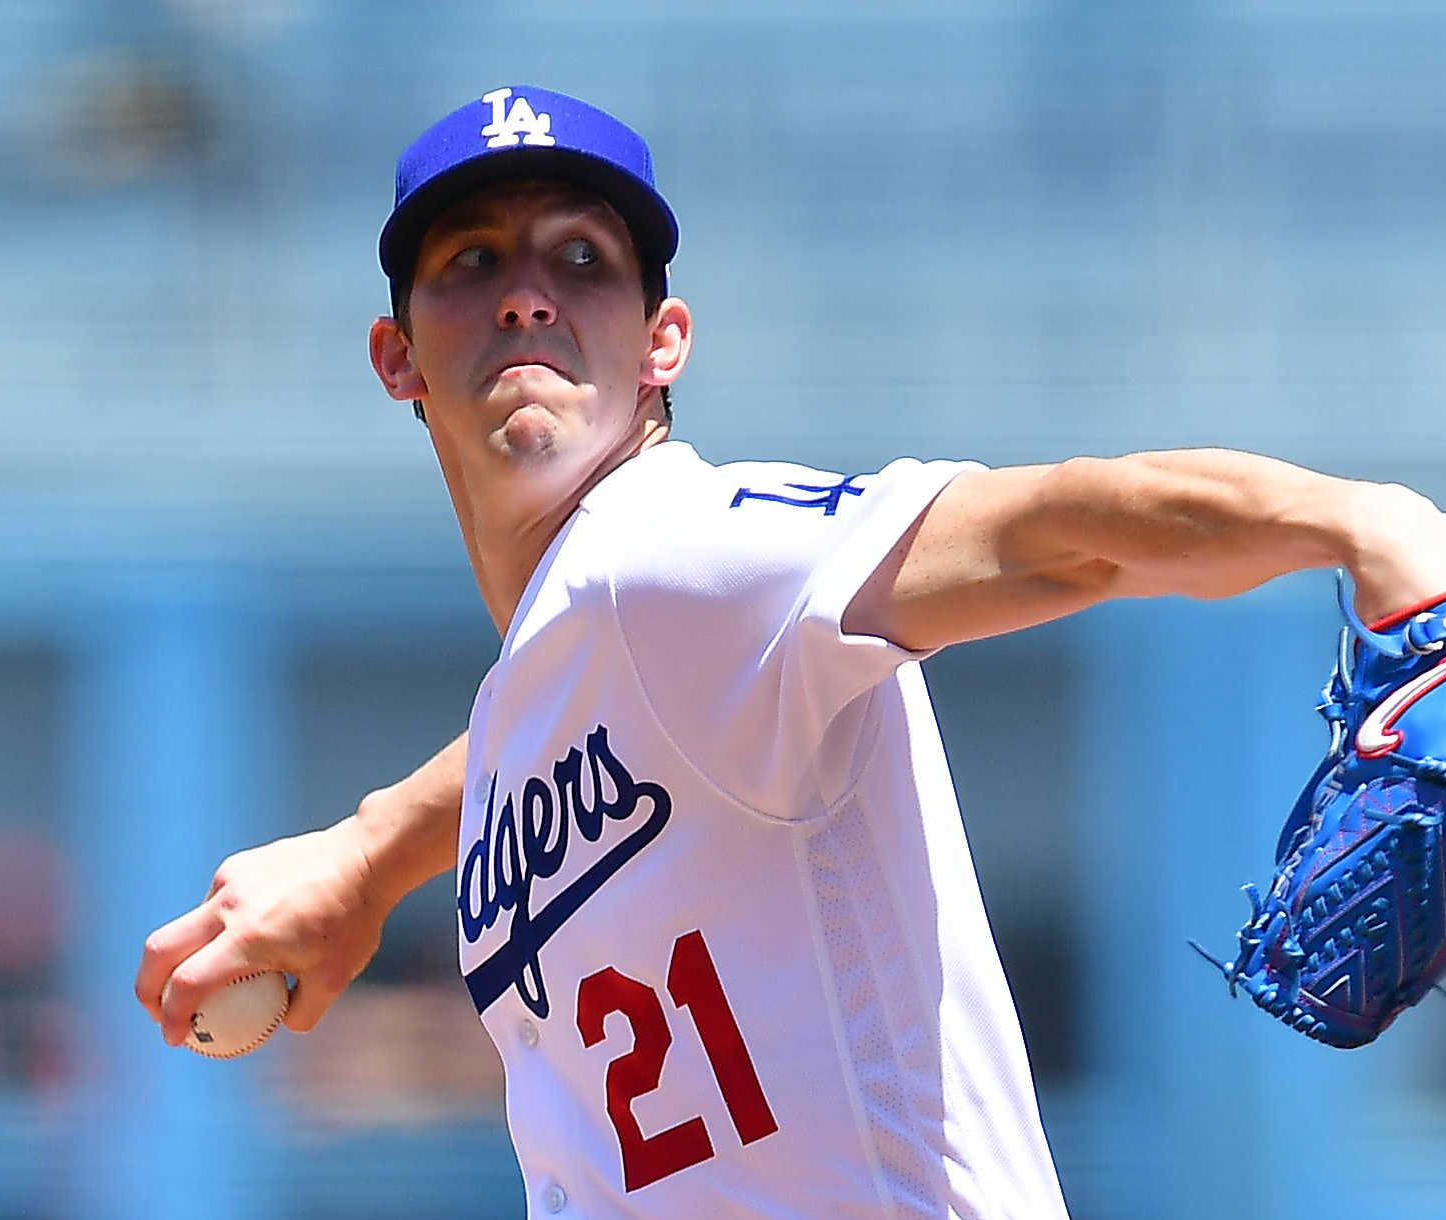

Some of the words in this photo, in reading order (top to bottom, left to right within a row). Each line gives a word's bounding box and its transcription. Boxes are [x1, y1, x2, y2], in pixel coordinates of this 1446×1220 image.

[481, 87, 556, 148] LA
[457, 723, 672, 1020] dgers
[576, 928, 779, 1194] 21
